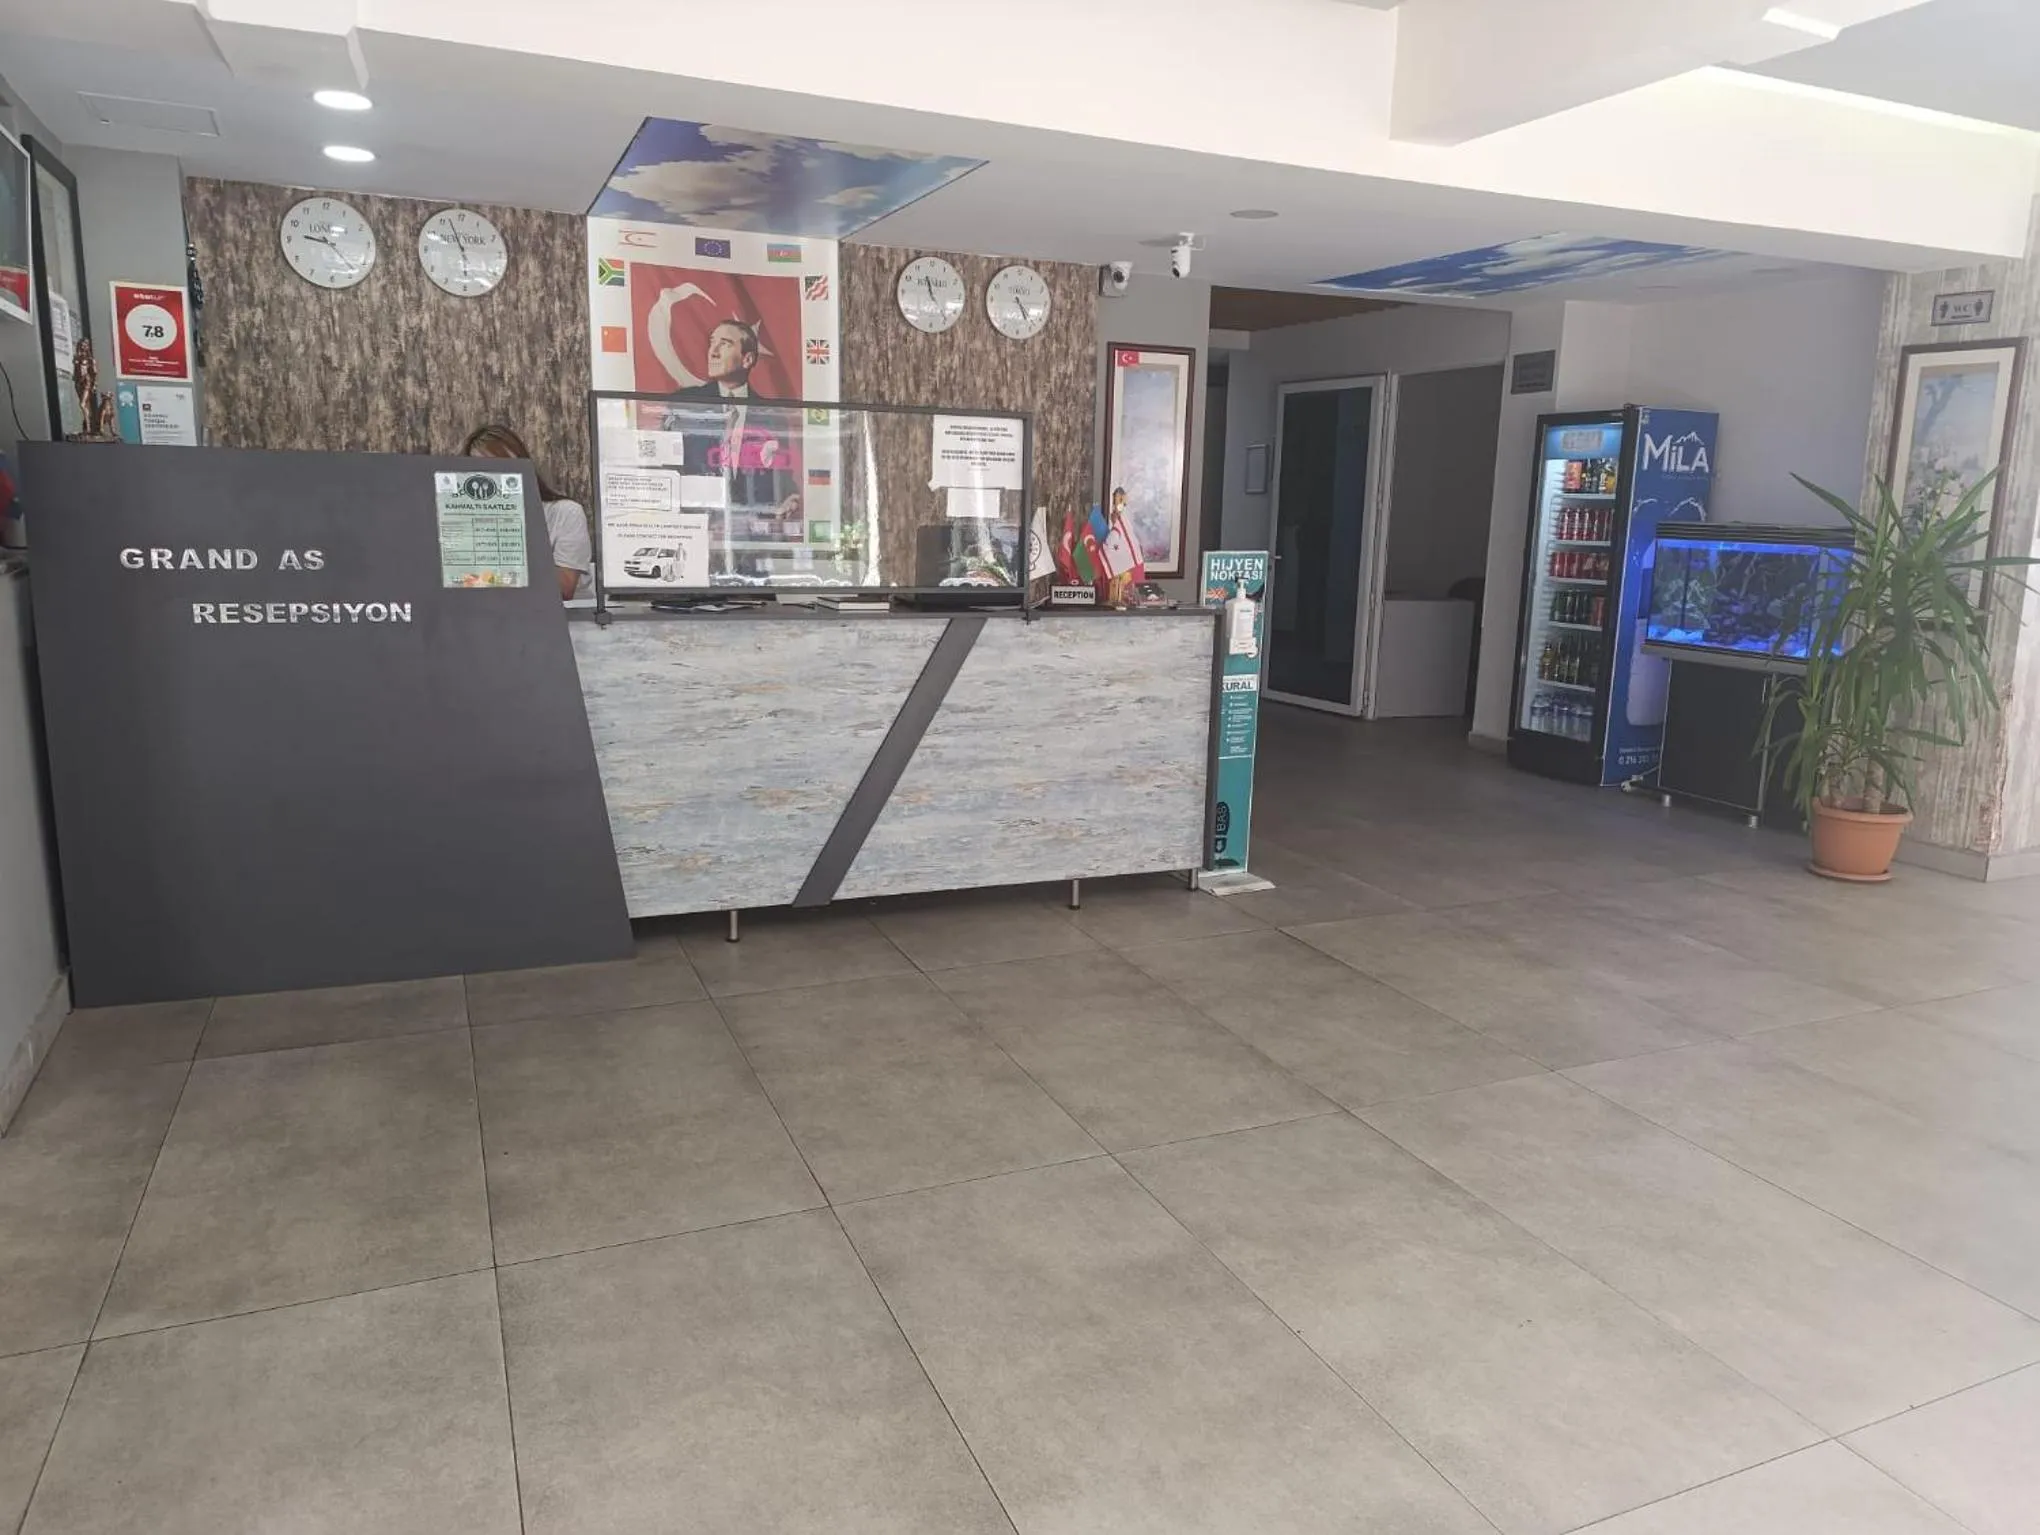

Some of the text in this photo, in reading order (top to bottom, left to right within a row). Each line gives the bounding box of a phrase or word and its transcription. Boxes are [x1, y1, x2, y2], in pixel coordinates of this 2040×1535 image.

[120, 548, 325, 570] GRAND AS
[1053, 590, 1094, 599] RECEPTION
[192, 602, 412, 624] RESEPSIYON
